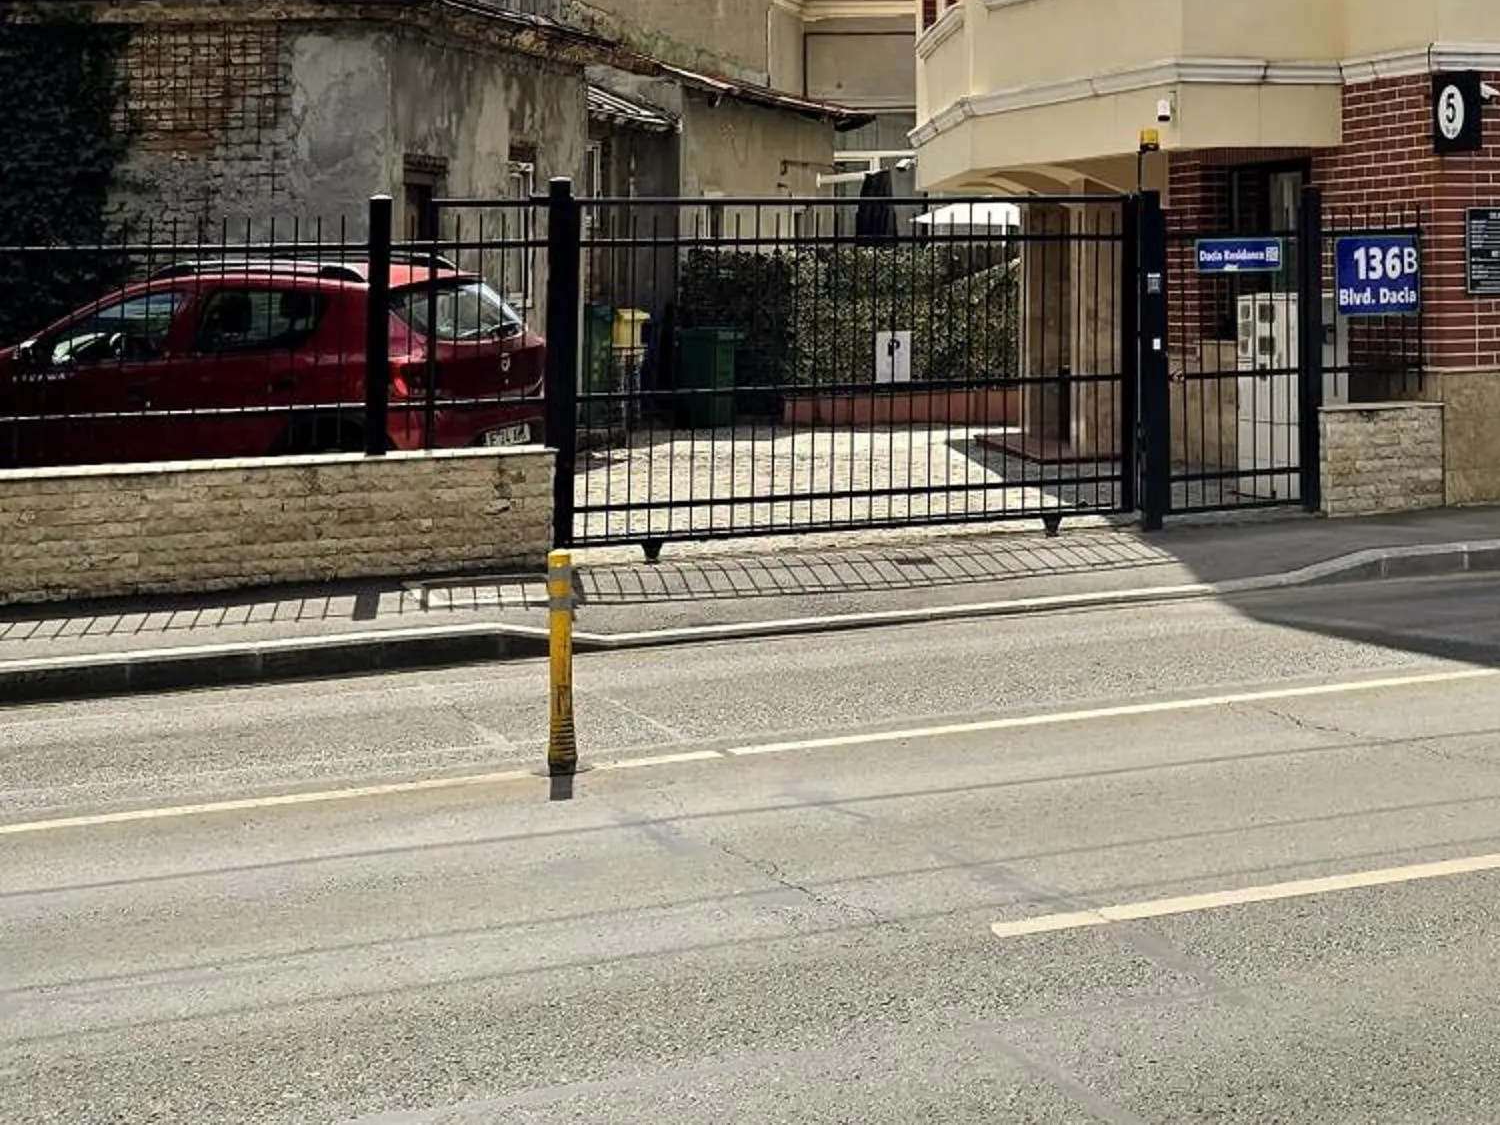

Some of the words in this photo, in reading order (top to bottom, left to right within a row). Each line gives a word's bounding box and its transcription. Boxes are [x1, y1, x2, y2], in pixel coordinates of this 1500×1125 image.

[1446, 93, 1456, 123] 5
[1353, 246, 1418, 280] 136B
[1339, 287, 1377, 306] Blvd.
[1380, 286, 1417, 304] Dacia
